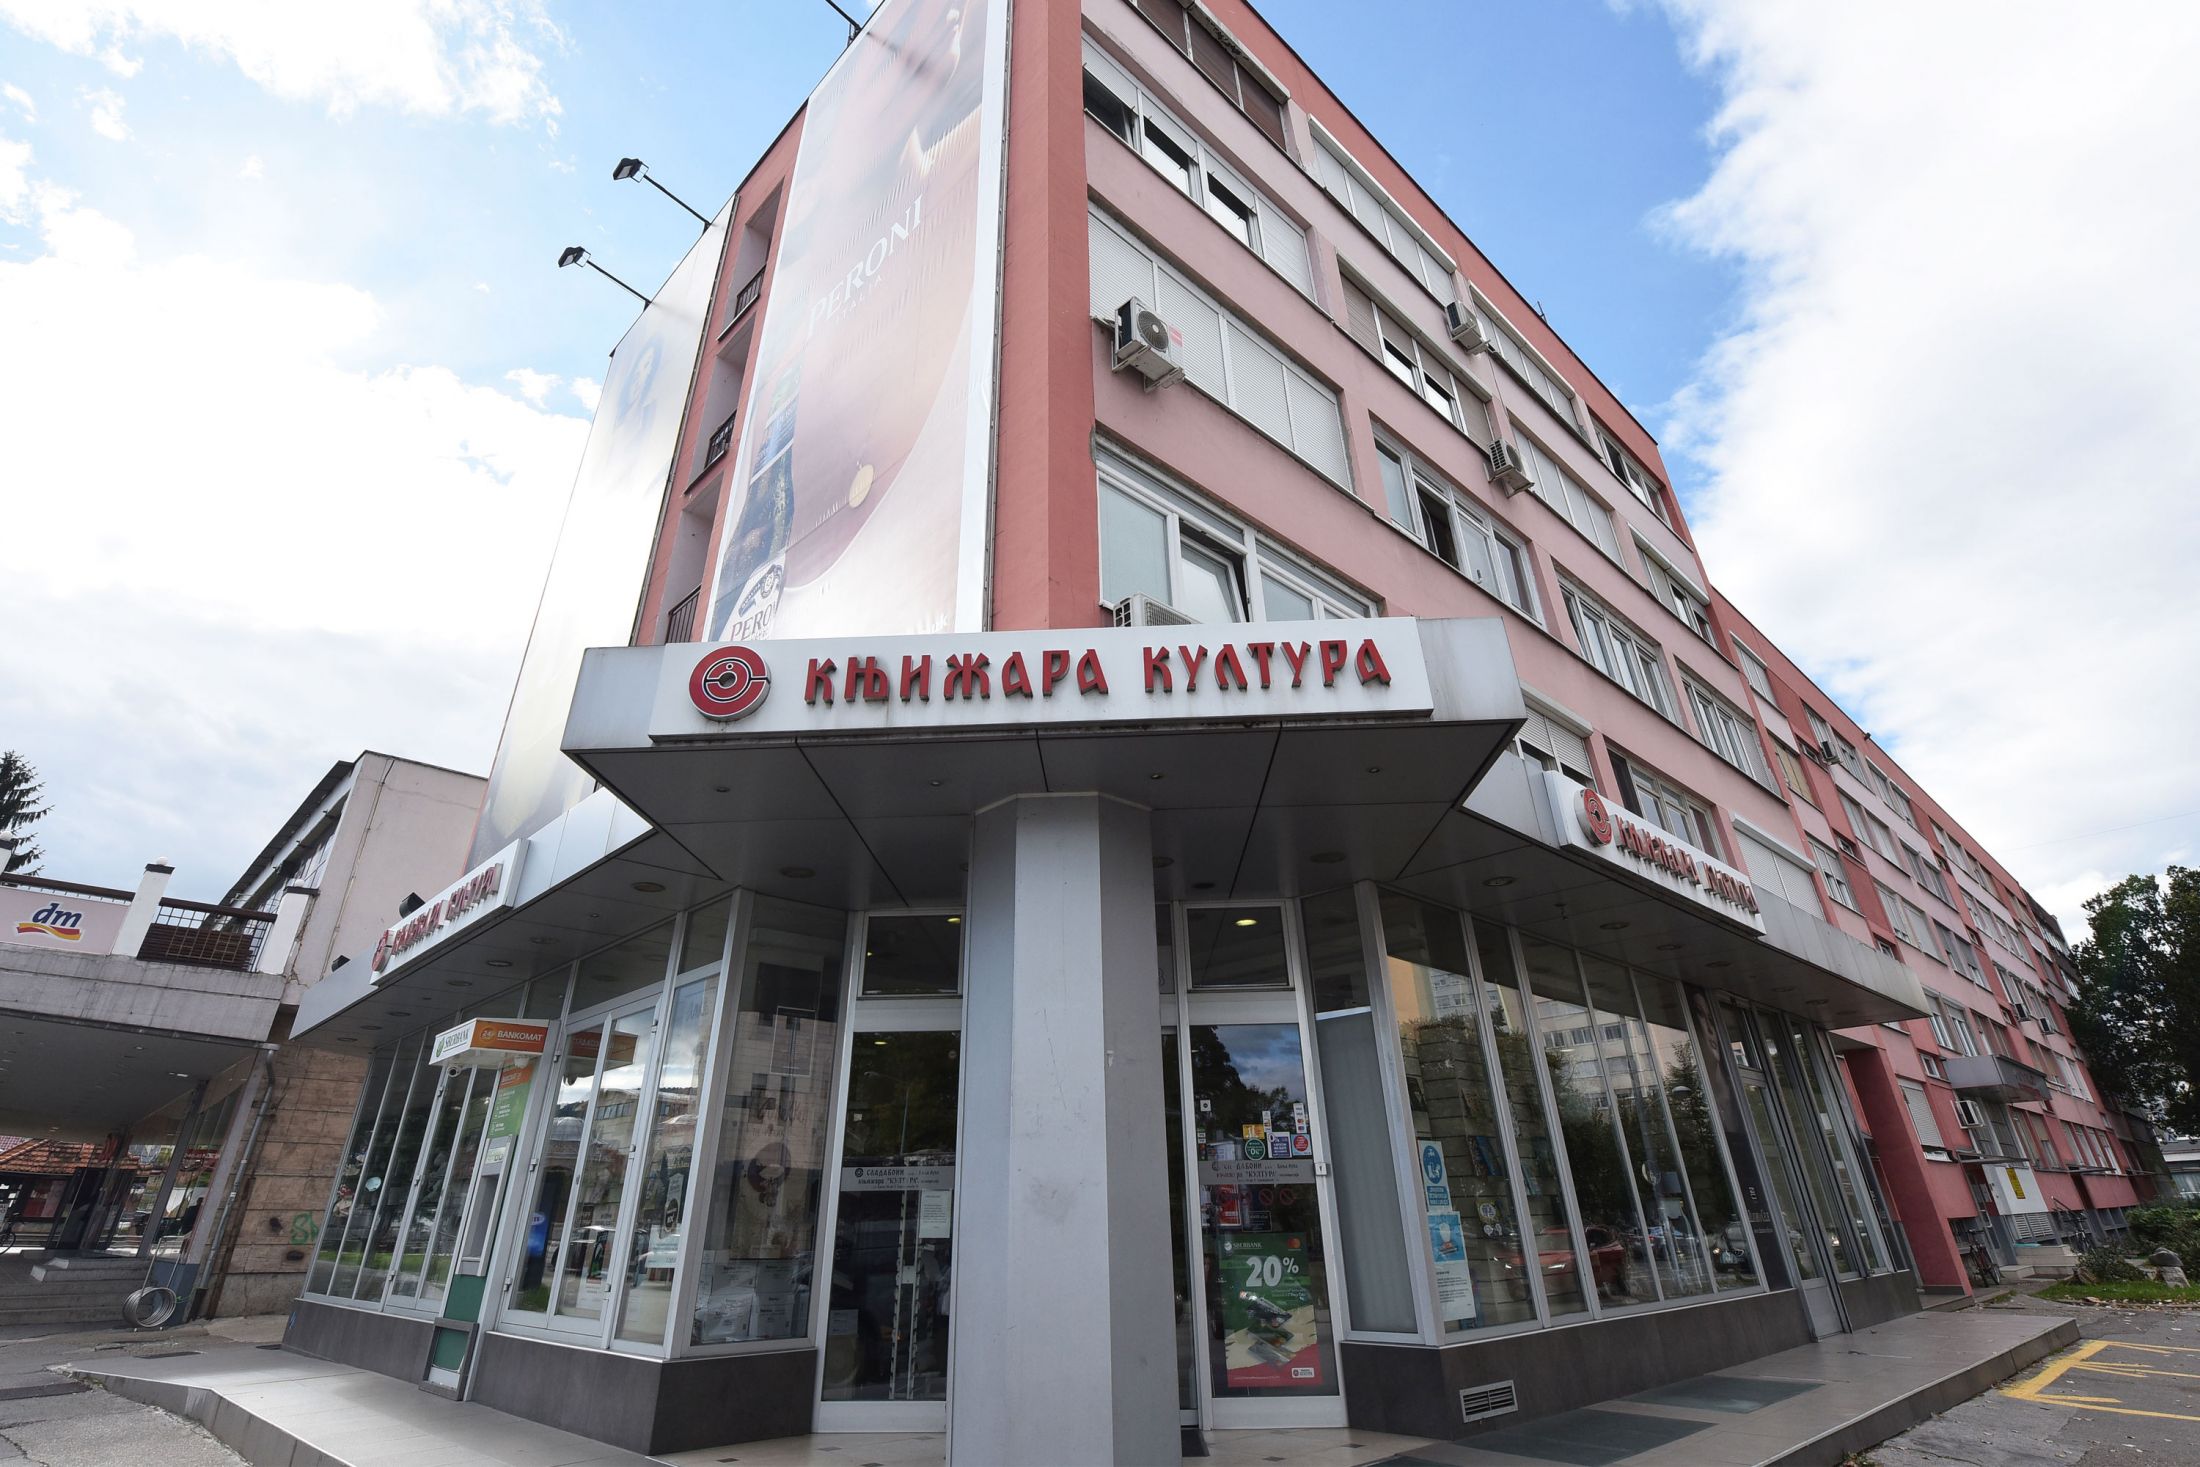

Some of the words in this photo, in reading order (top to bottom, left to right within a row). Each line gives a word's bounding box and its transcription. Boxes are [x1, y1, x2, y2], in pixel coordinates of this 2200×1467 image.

[808, 194, 922, 337] PERONI
[804, 648, 1109, 706] КЊИЖАРА
[1143, 638, 1393, 694] КУЛТУРА
[32, 902, 82, 928] dm
[497, 1030, 543, 1041] BANKOMAT
[1245, 1255, 1299, 1287] 20%
